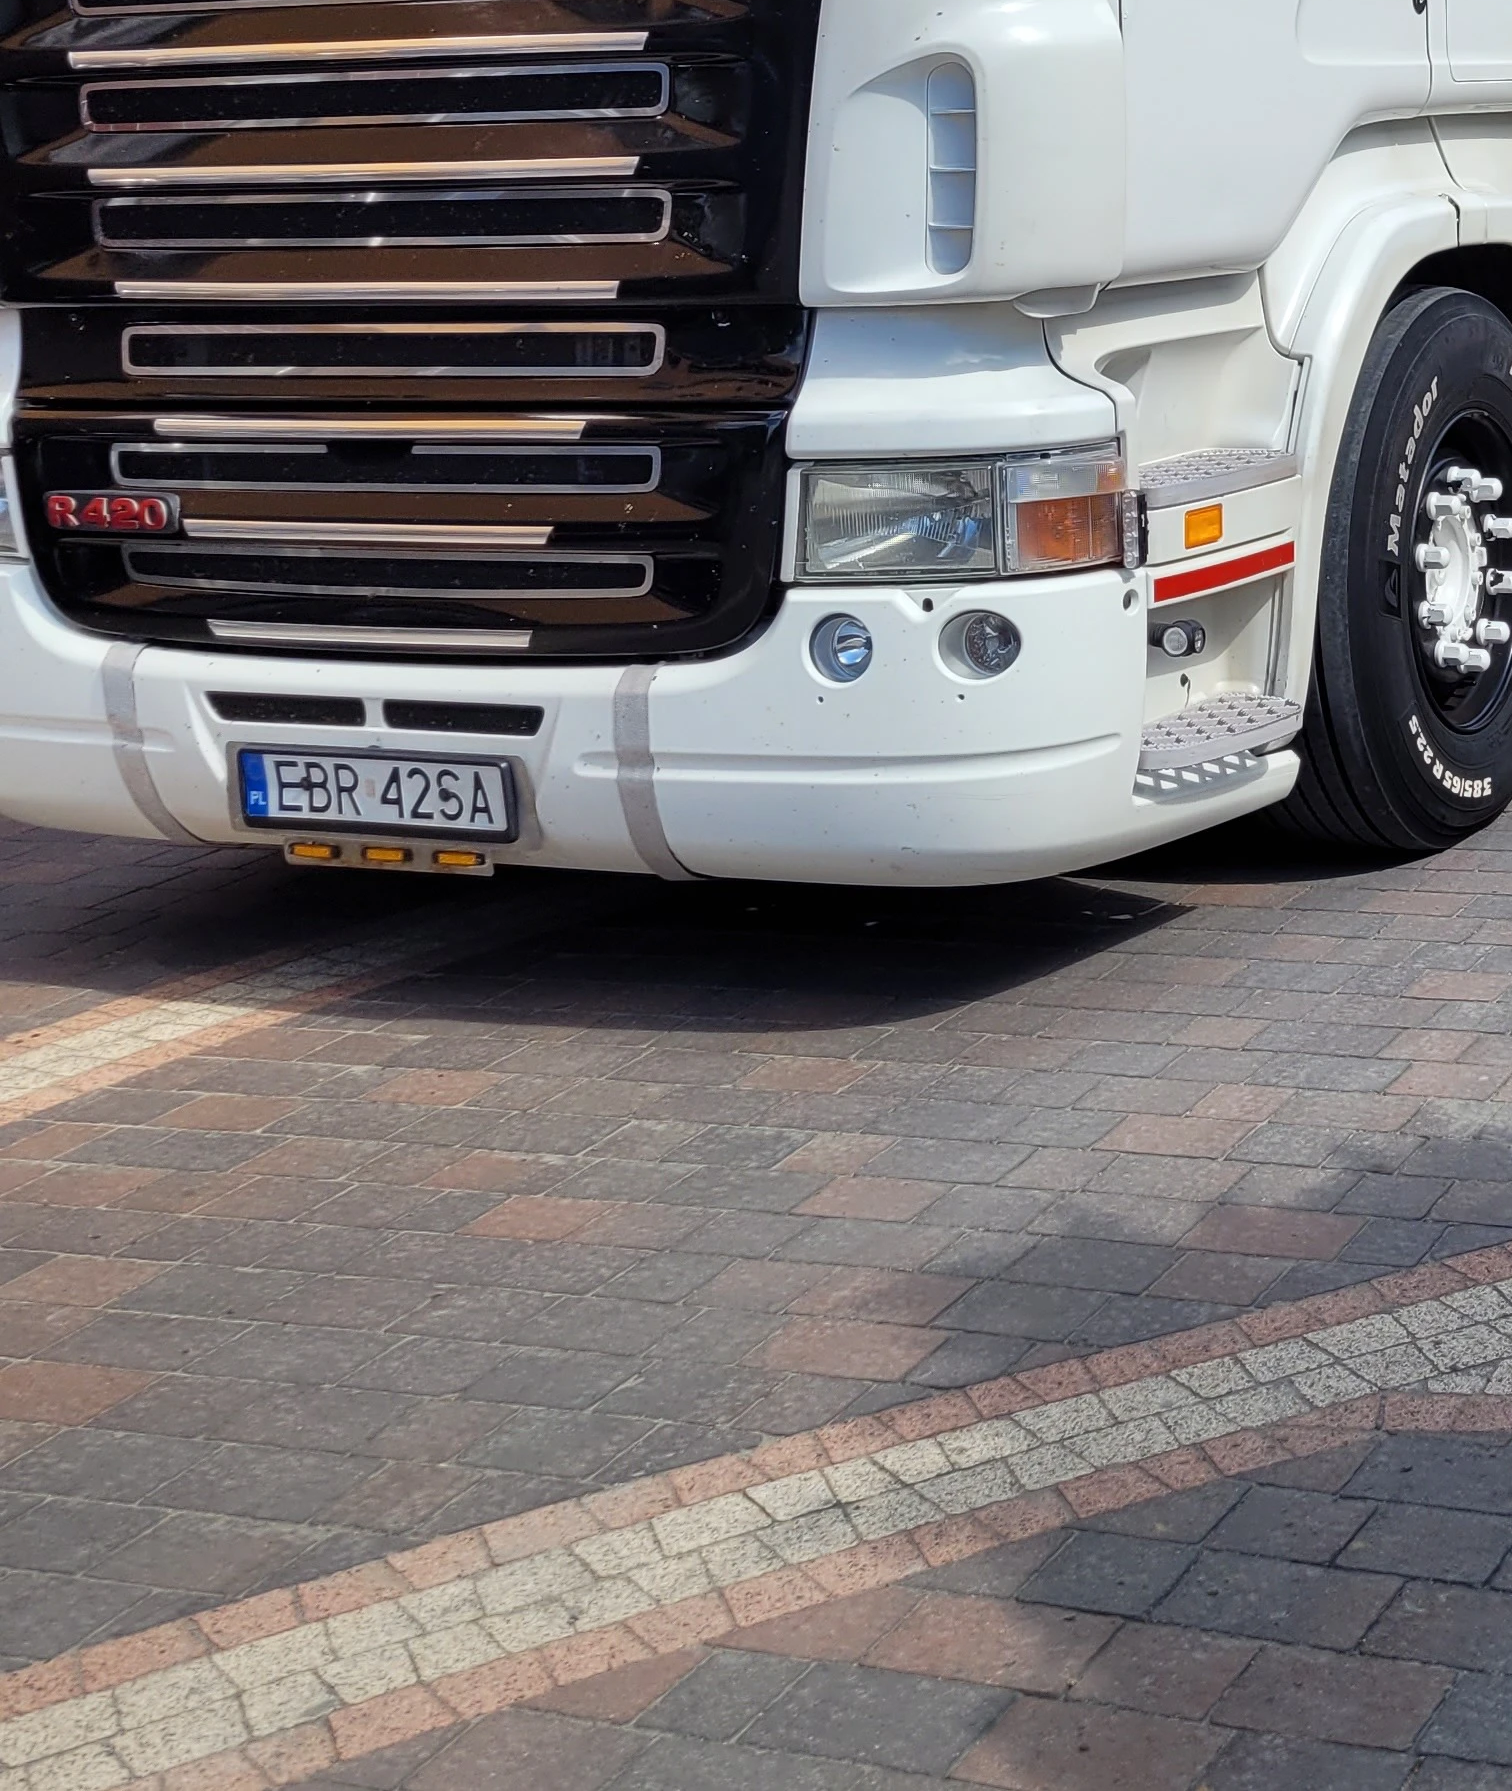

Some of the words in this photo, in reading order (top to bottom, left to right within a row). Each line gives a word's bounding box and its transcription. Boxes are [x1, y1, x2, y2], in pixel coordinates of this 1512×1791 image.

[1387, 375, 1438, 557] Matador
[48, 495, 81, 527] R
[80, 497, 168, 530] 420
[250, 790, 267, 806] PL
[273, 760, 362, 816] EBR
[1442, 770, 1492, 798] 385/65
